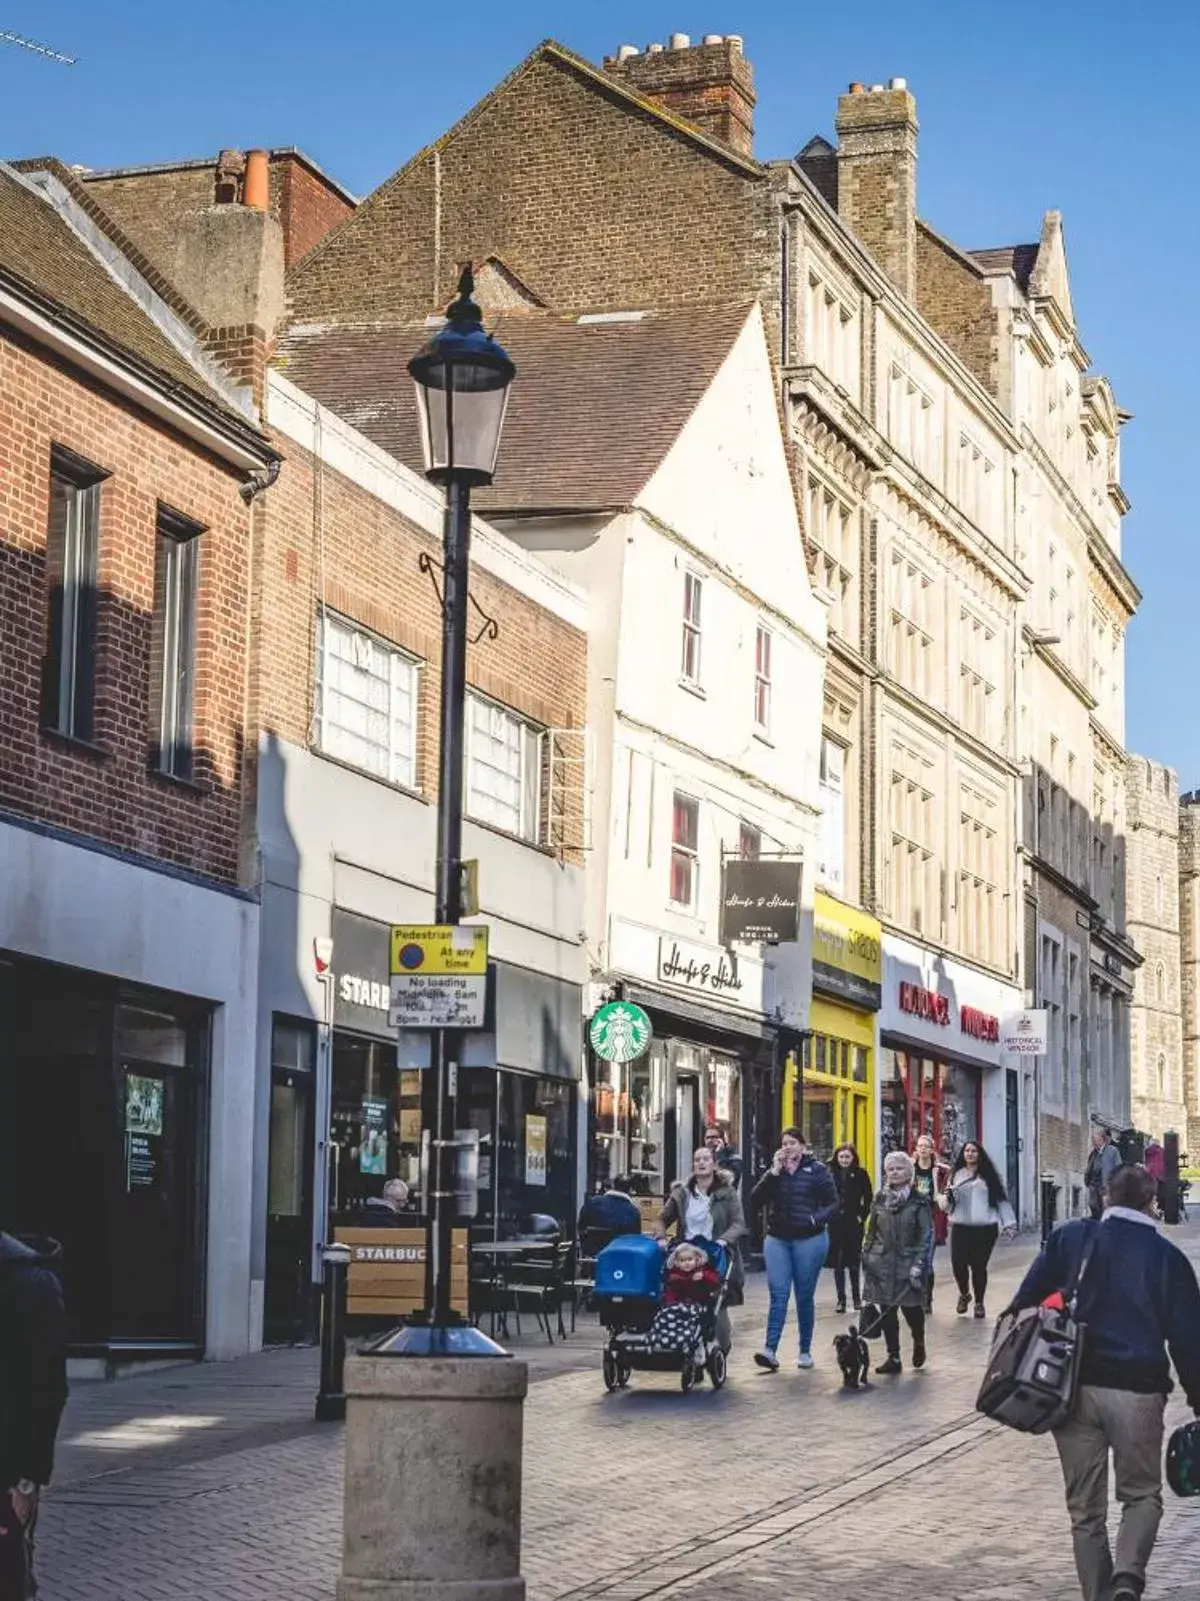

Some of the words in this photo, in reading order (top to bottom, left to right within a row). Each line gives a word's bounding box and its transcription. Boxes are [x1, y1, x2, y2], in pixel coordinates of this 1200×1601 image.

[395, 929, 453, 941] Pedestrian
[445, 959, 470, 969] time
[409, 978, 425, 988] No
[428, 977, 467, 989] loading
[340, 974, 390, 1010] STARB
[355, 1248, 427, 1260] STARBUC
